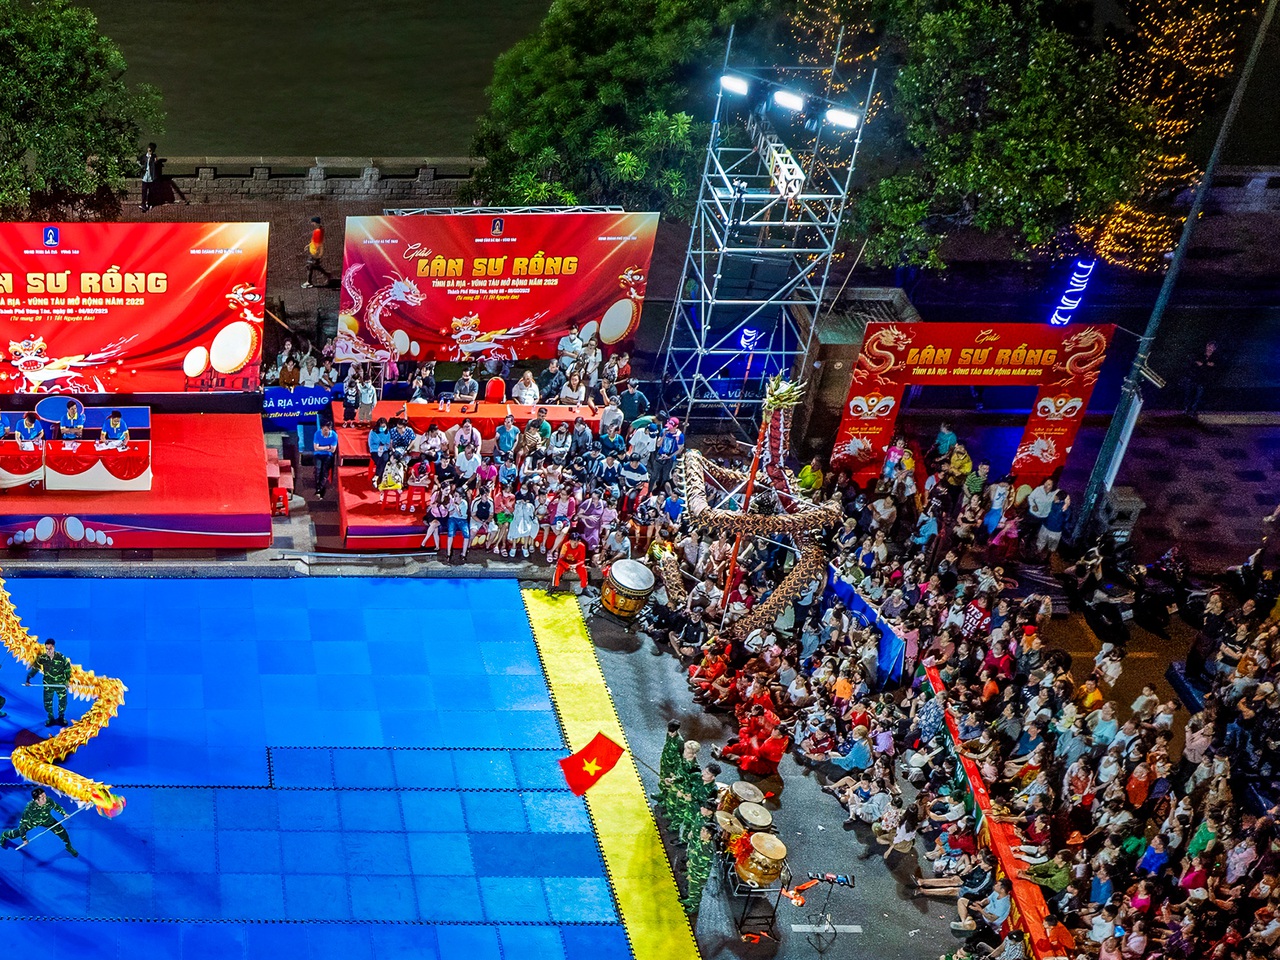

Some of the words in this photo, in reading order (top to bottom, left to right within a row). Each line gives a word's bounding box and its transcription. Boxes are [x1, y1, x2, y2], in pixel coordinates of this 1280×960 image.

[416, 254, 464, 277] LÂN
[472, 255, 508, 276] SƯ
[512, 250, 578, 276] RỒNG
[26, 270, 71, 293] SƯ
[80, 265, 167, 293] RỒNG
[488, 279, 499, 287] TÀU
[6, 298, 21, 307] RỊA
[27, 296, 49, 306] VŨNG
[50, 296, 66, 306] TÀU
[67, 296, 81, 306] MỞ
[82, 296, 103, 307] RỘNG
[105, 296, 123, 305] NĂM
[125, 298, 144, 306] 2025
[906, 344, 952, 365] LÂN
[958, 346, 993, 365] SƯ
[995, 343, 1058, 365] RỒNG
[1026, 368, 1043, 376] 2025
[277, 399, 294, 409] RỊA
[301, 395, 329, 406] VŨNG
